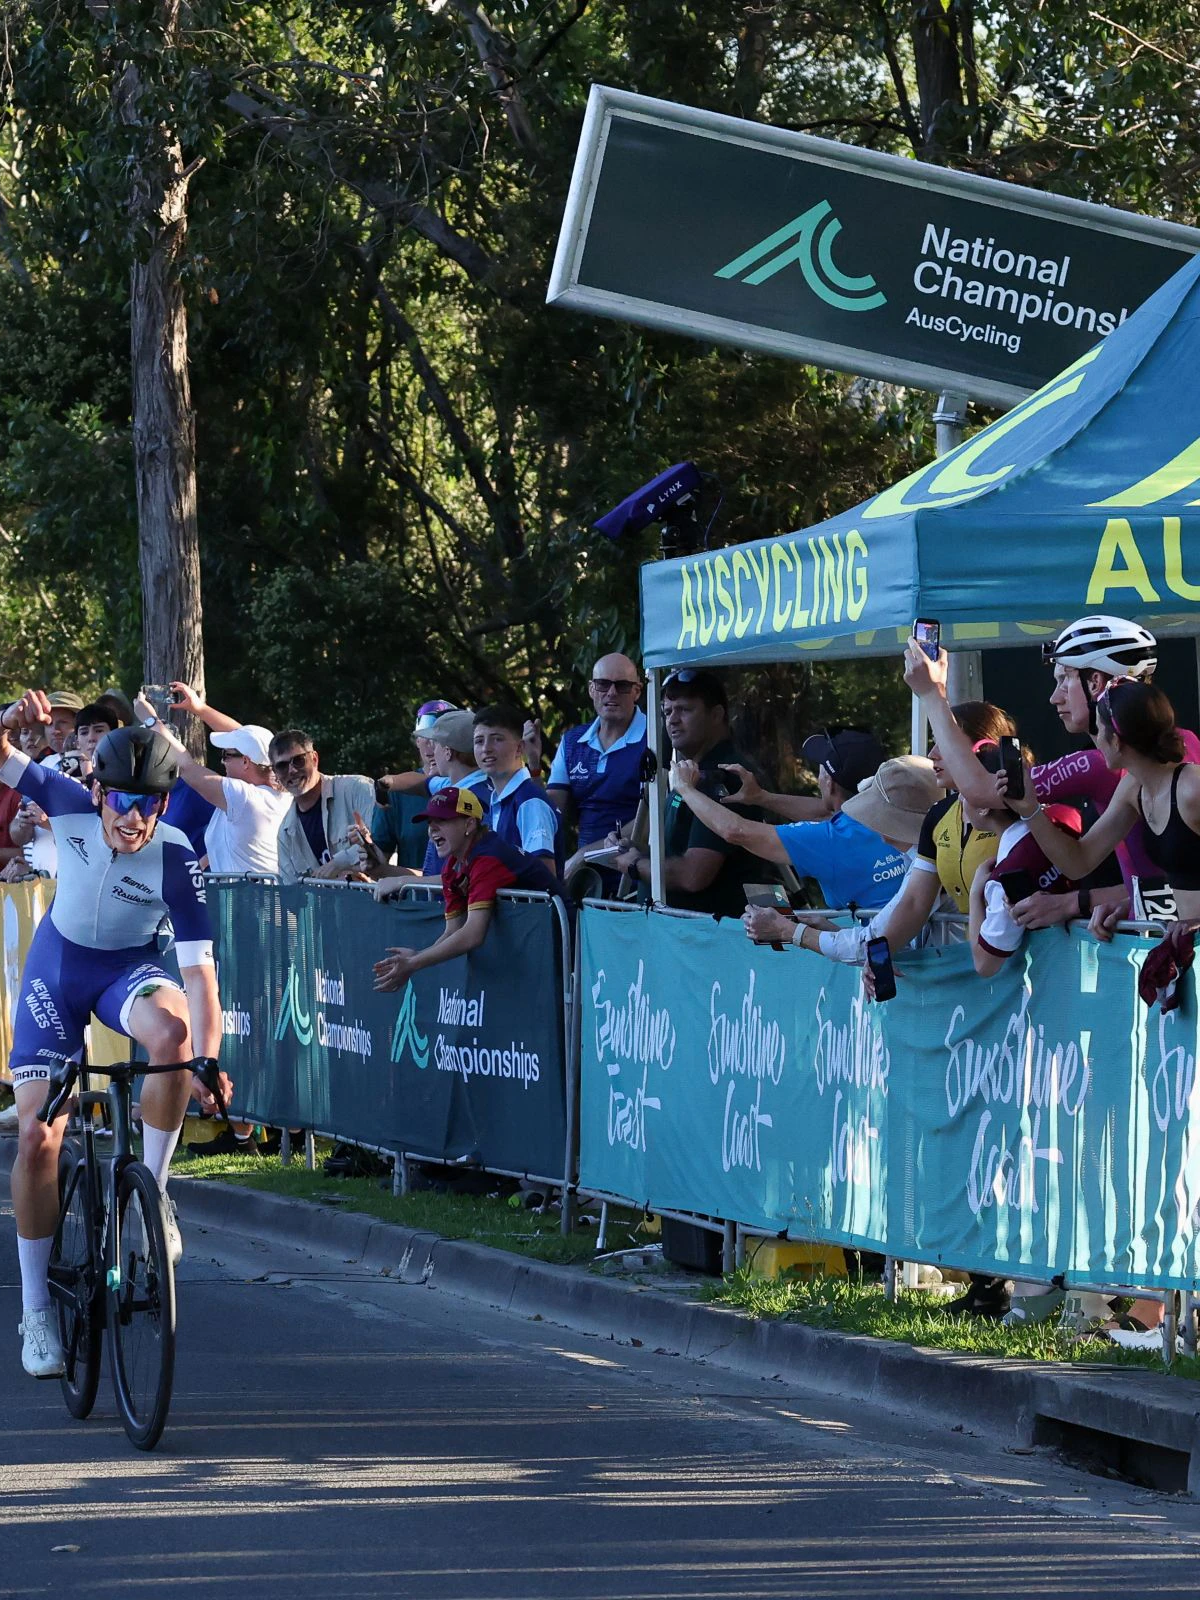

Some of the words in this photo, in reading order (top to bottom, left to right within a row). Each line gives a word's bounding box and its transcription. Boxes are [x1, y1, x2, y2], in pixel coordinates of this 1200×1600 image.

[920, 223, 1071, 288] National
[913, 261, 1134, 336] Champions
[905, 309, 1021, 354] AusCycling
[659, 480, 682, 503] LYNX
[677, 529, 868, 650] AUSCYCLING
[1034, 755, 1090, 796] cycling
[121, 876, 154, 895] Santini
[185, 860, 207, 904] NSW
[24, 992, 51, 1030] WALES
[30, 978, 52, 1001] NEW
[42, 1000, 67, 1041] SOUTH
[315, 968, 345, 1006] National
[437, 987, 484, 1027] National
[591, 958, 676, 1070] Sunshine
[317, 1010, 372, 1064] Championships
[707, 968, 785, 1085] Sunshine
[945, 984, 1088, 1118] Sunshine
[434, 1033, 540, 1090] Championships
[607, 1063, 661, 1153] Coast
[721, 1079, 773, 1172] Coast
